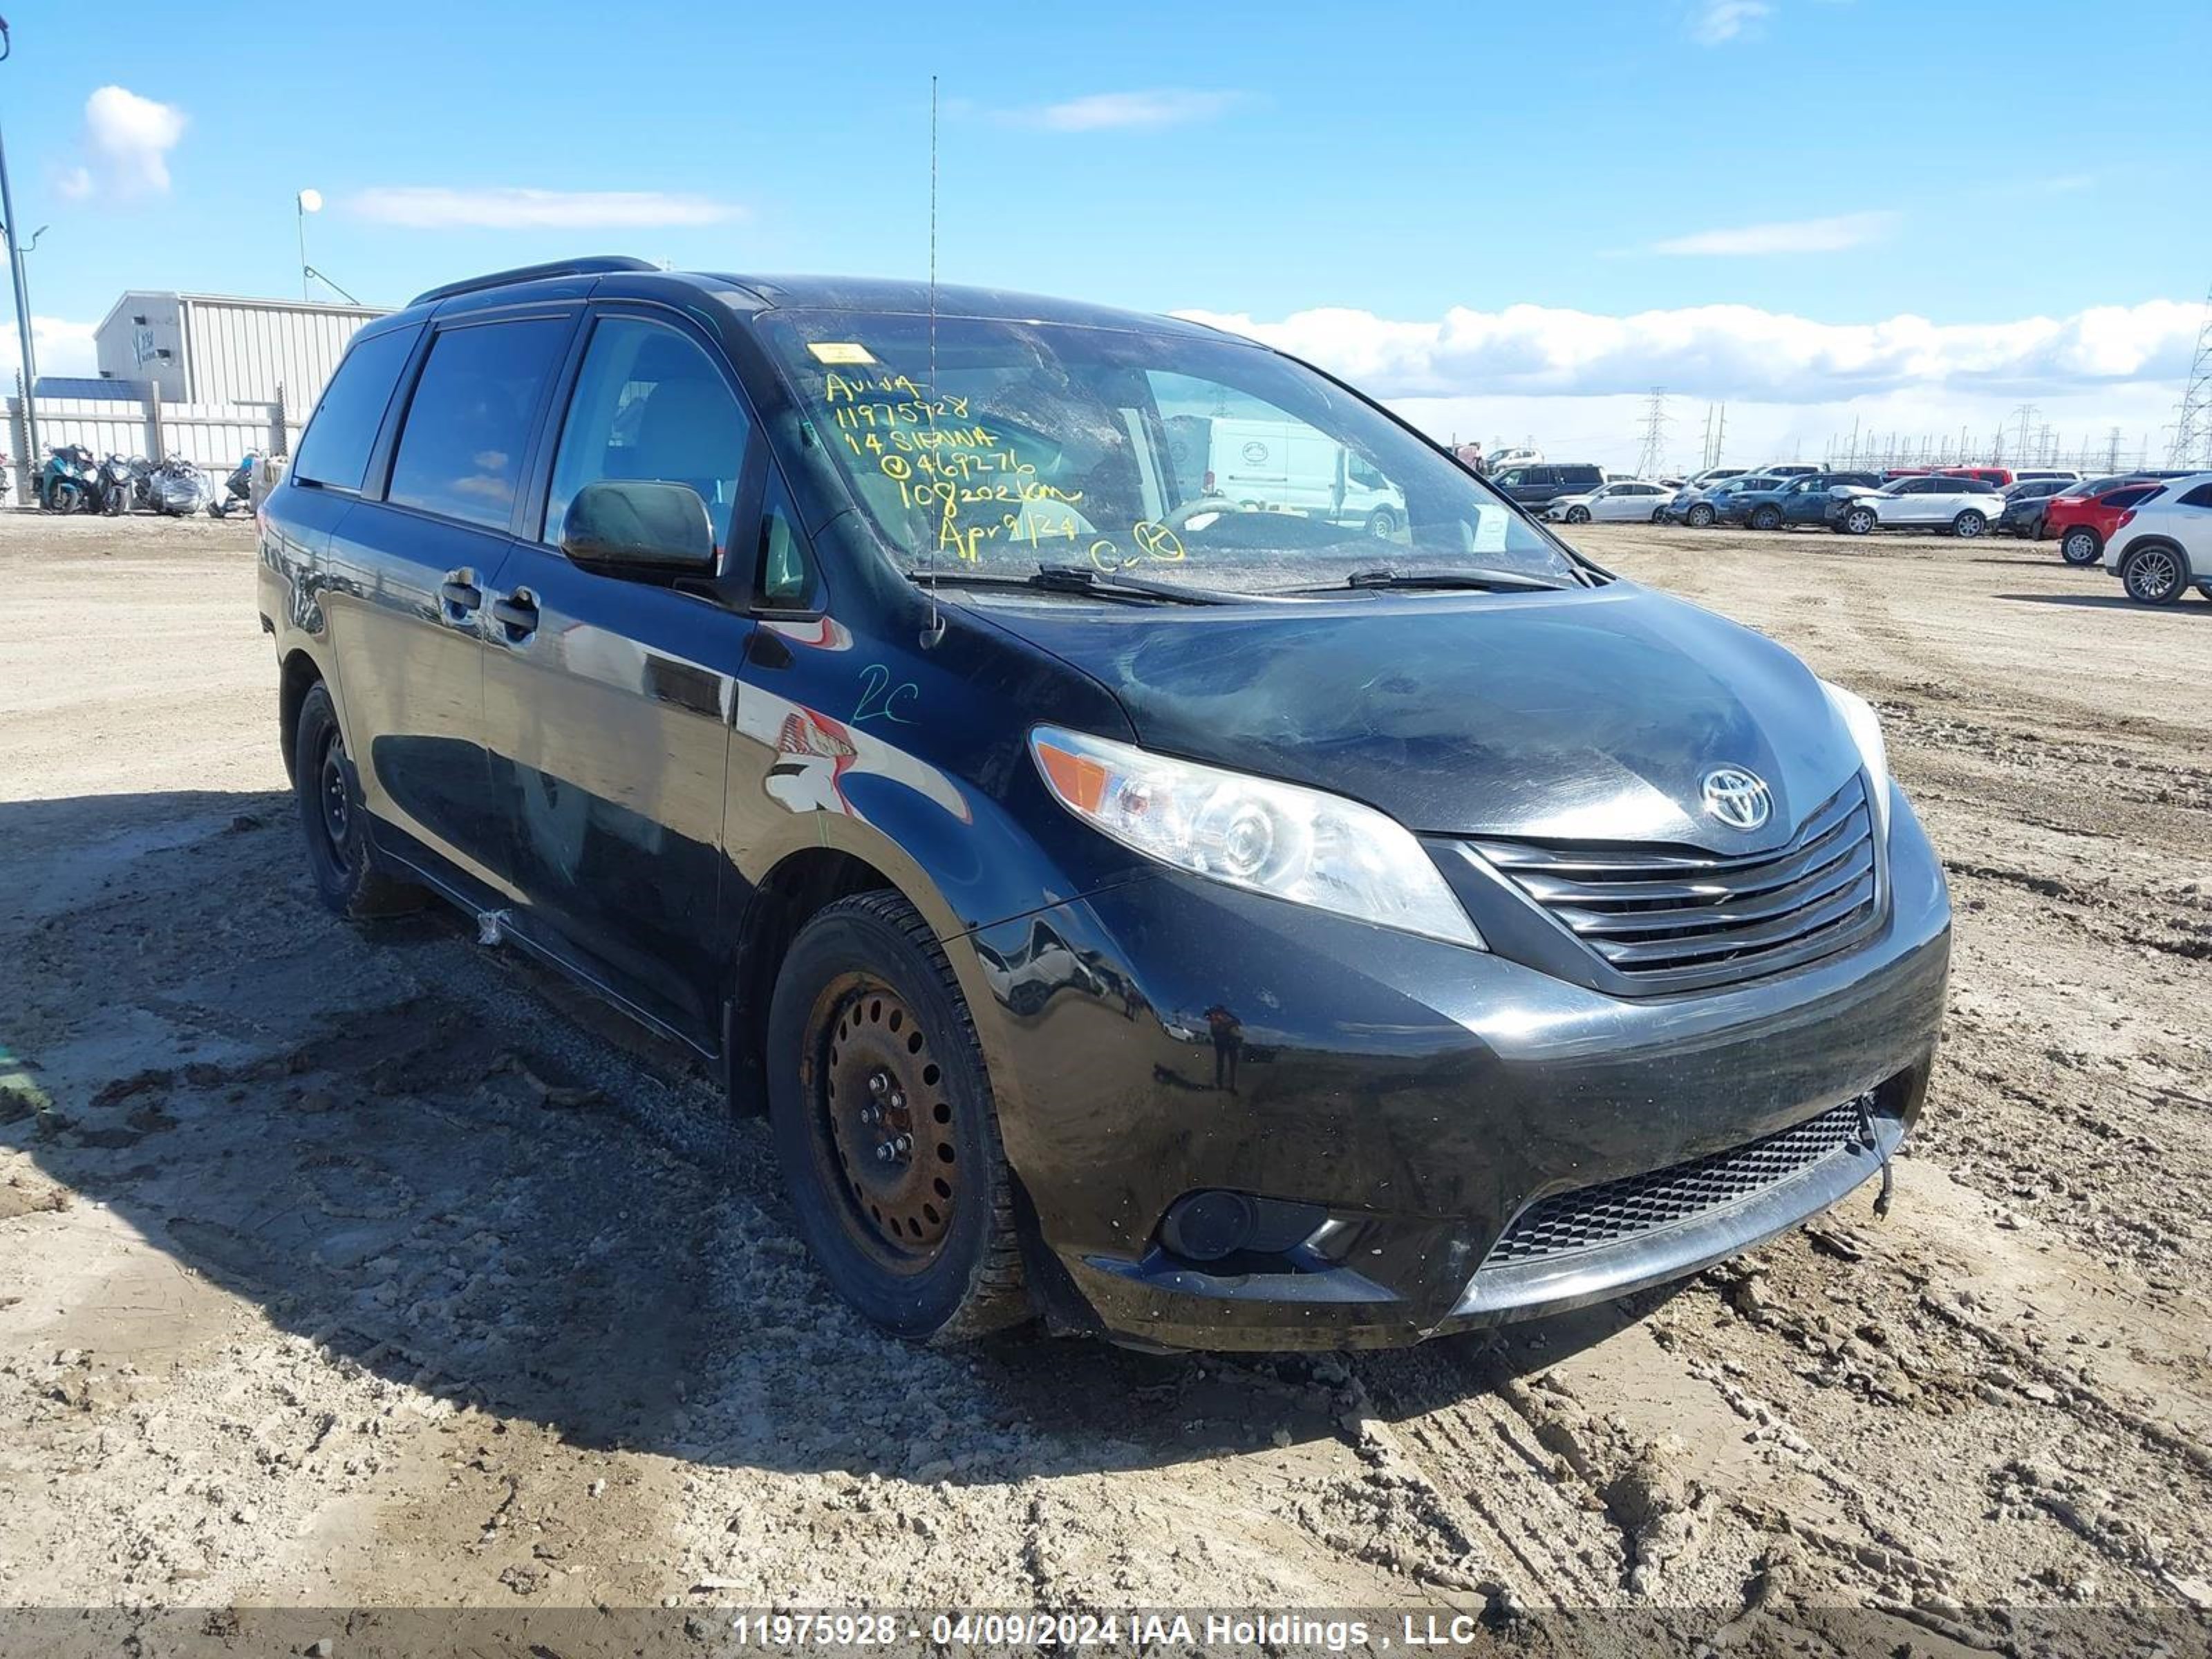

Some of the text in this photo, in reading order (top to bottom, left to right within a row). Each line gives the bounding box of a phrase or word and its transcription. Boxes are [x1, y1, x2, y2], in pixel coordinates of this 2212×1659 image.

[836, 394, 968, 429] 11975928
[845, 426, 1000, 456] 14 SIENNA
